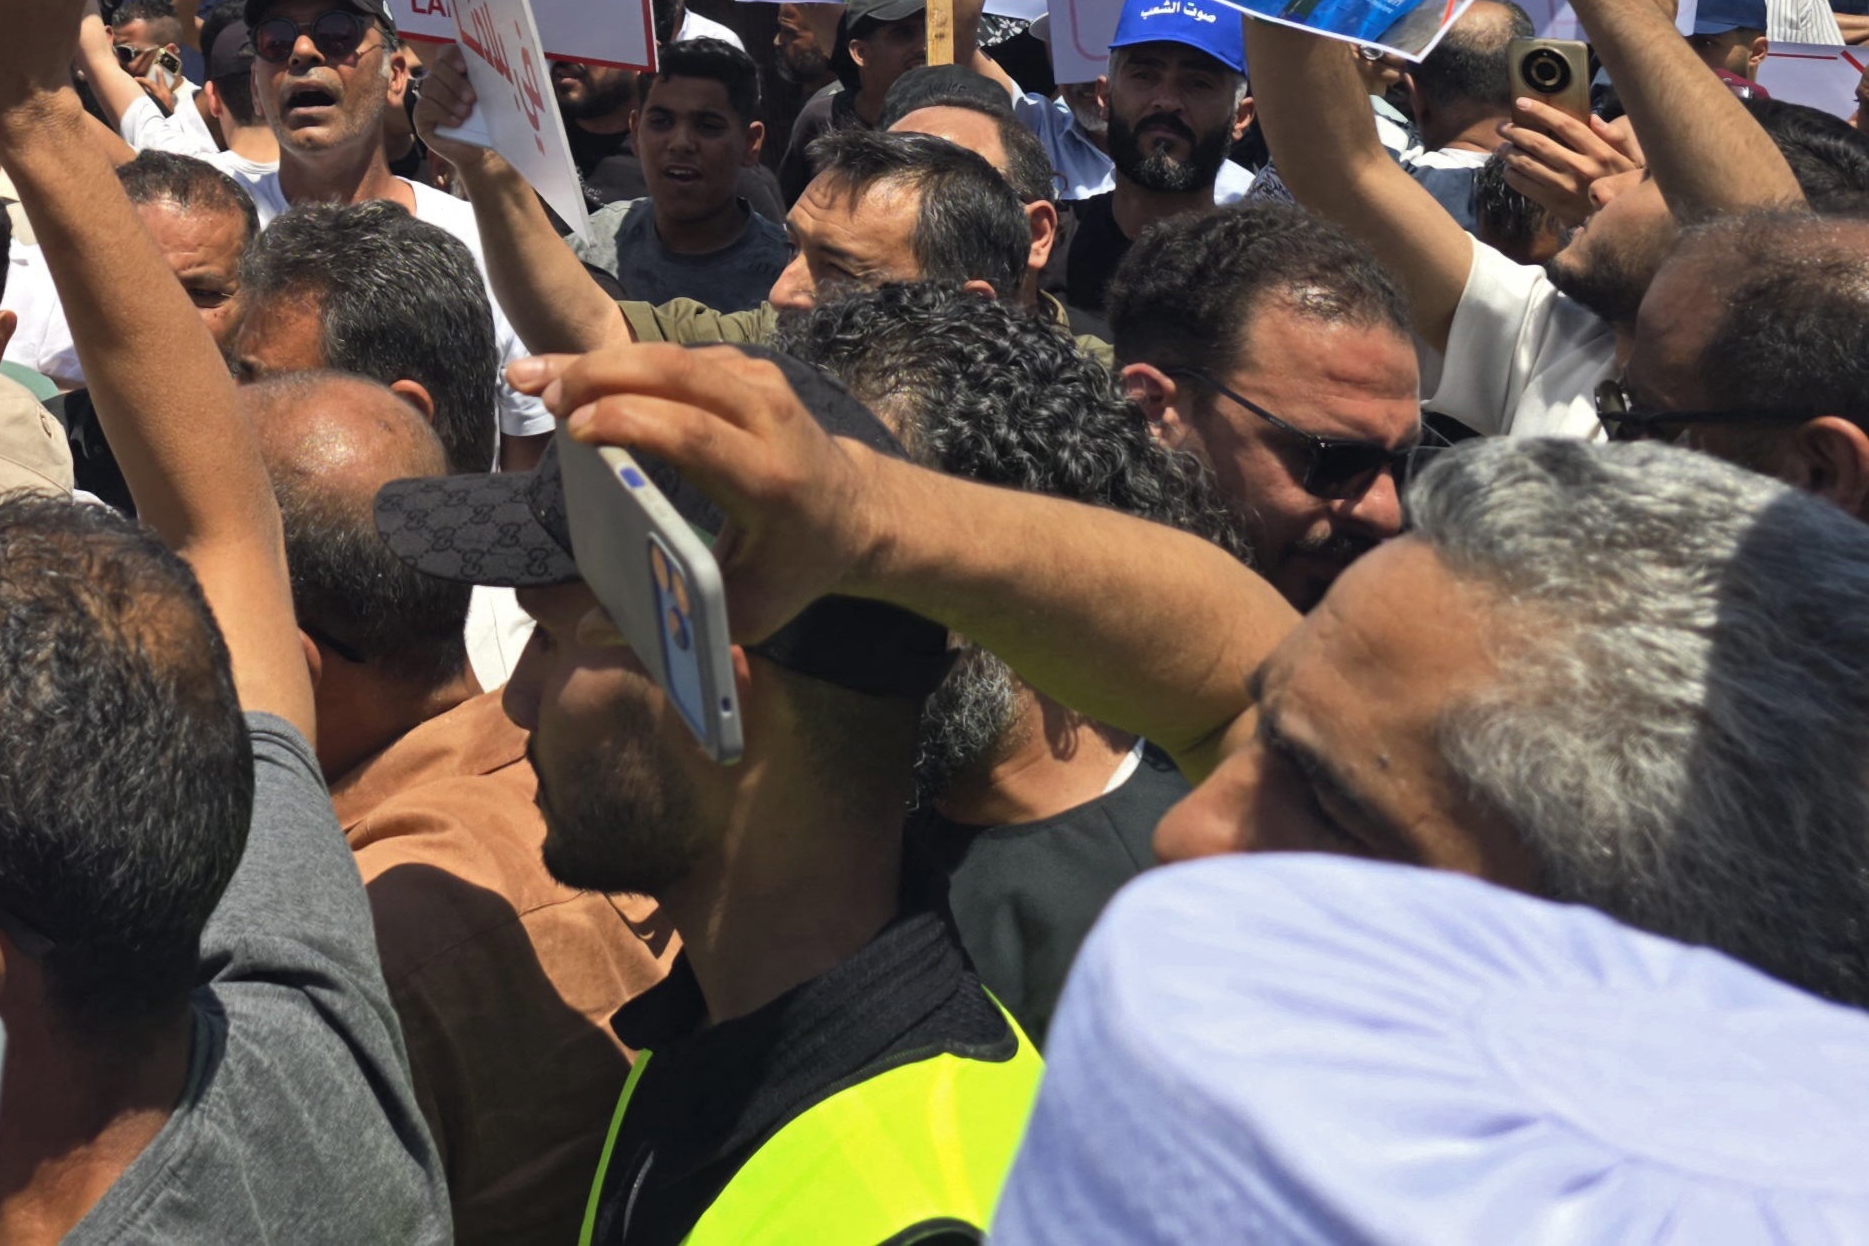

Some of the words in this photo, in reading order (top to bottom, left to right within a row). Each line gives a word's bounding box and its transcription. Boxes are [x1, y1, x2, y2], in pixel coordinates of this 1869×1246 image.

[1141, 0, 1180, 20] الشعب
[1183, 2, 1216, 23] صوت
[514, 19, 546, 156] في
